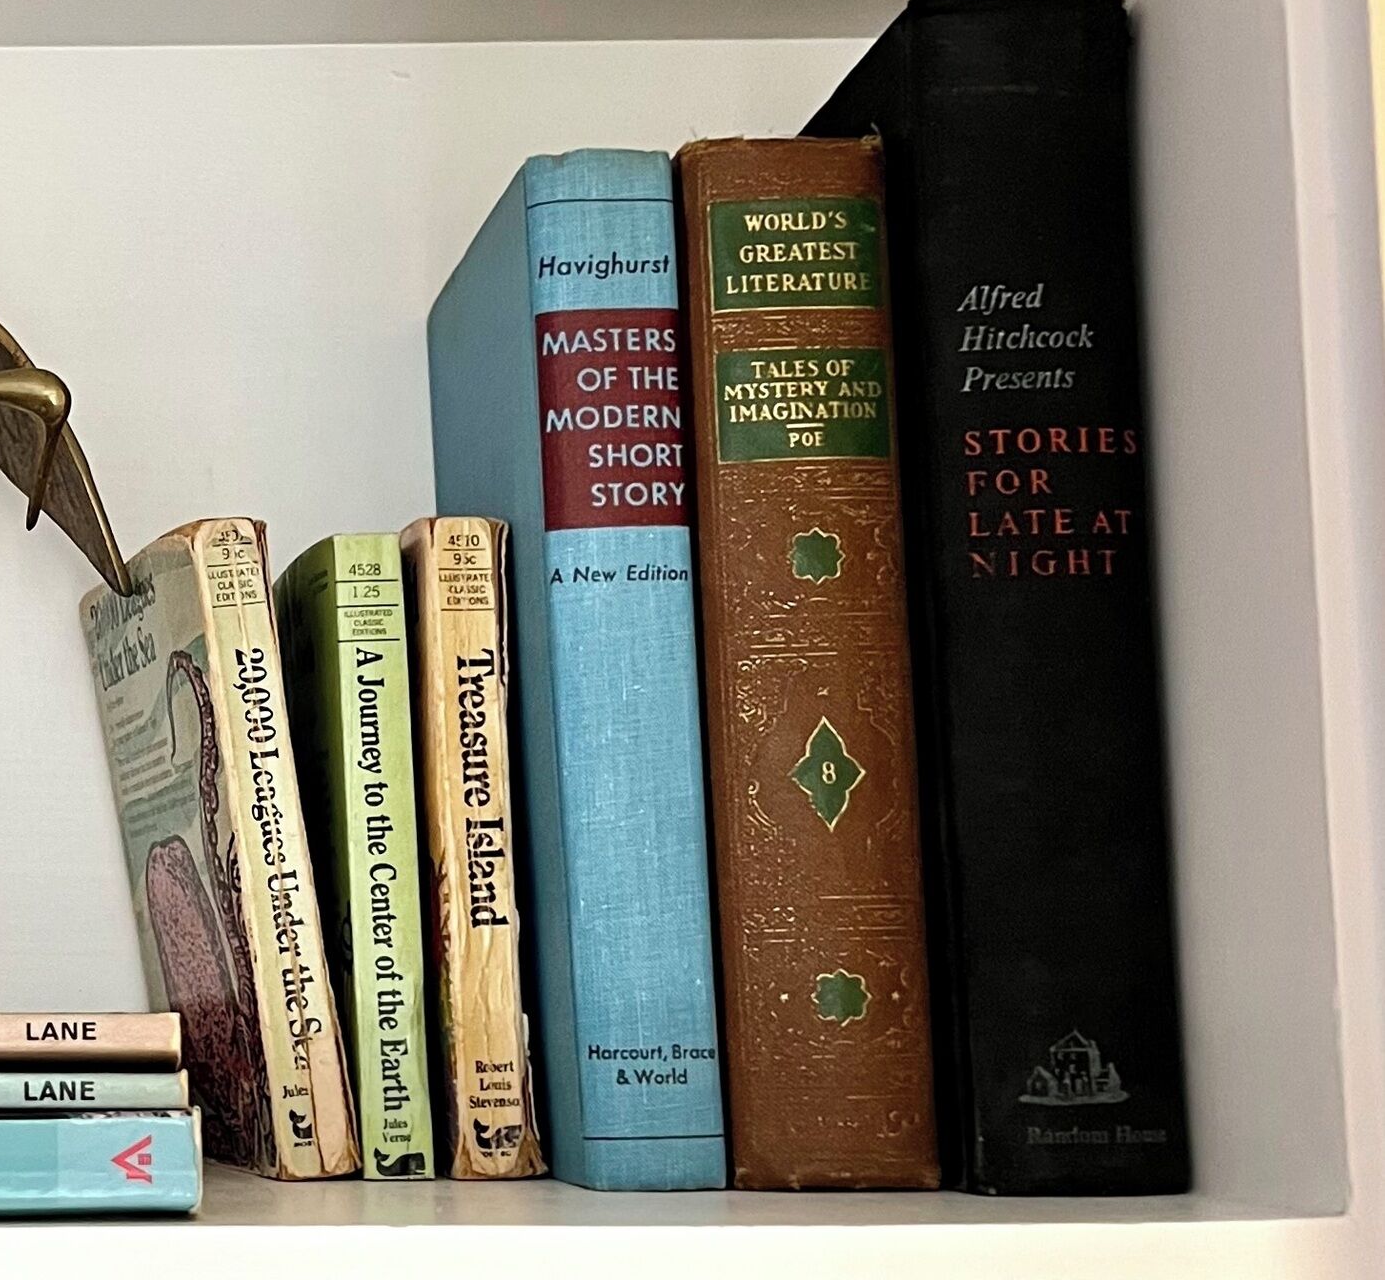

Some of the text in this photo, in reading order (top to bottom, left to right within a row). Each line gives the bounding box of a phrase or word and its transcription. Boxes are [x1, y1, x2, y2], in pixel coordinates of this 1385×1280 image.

[740, 242, 859, 263] GREATEST
[538, 253, 669, 279] Havighurst
[725, 272, 873, 294] LITERATURE
[958, 284, 1044, 315] Alfred
[542, 330, 675, 355] MASTERS
[960, 325, 1093, 353] Hitchcock
[962, 366, 1075, 392] Presents
[546, 406, 681, 431] MODERN
[789, 431, 823, 448] POE
[964, 427, 1138, 455] STORIES
[589, 444, 683, 469] SHORT
[591, 482, 685, 507] STORY
[969, 510, 1132, 536] LATE AT
[550, 566, 688, 584] A New Edition
[822, 762, 835, 784] 8
[457, 648, 508, 928] Treasure Island
[356, 648, 411, 1111] A Journey to the Center of the Earth
[25, 1021, 97, 1041] LANE
[587, 1044, 666, 1062] Harcourt,
[635, 1068, 687, 1086] World
[23, 1081, 96, 1101] LANE
